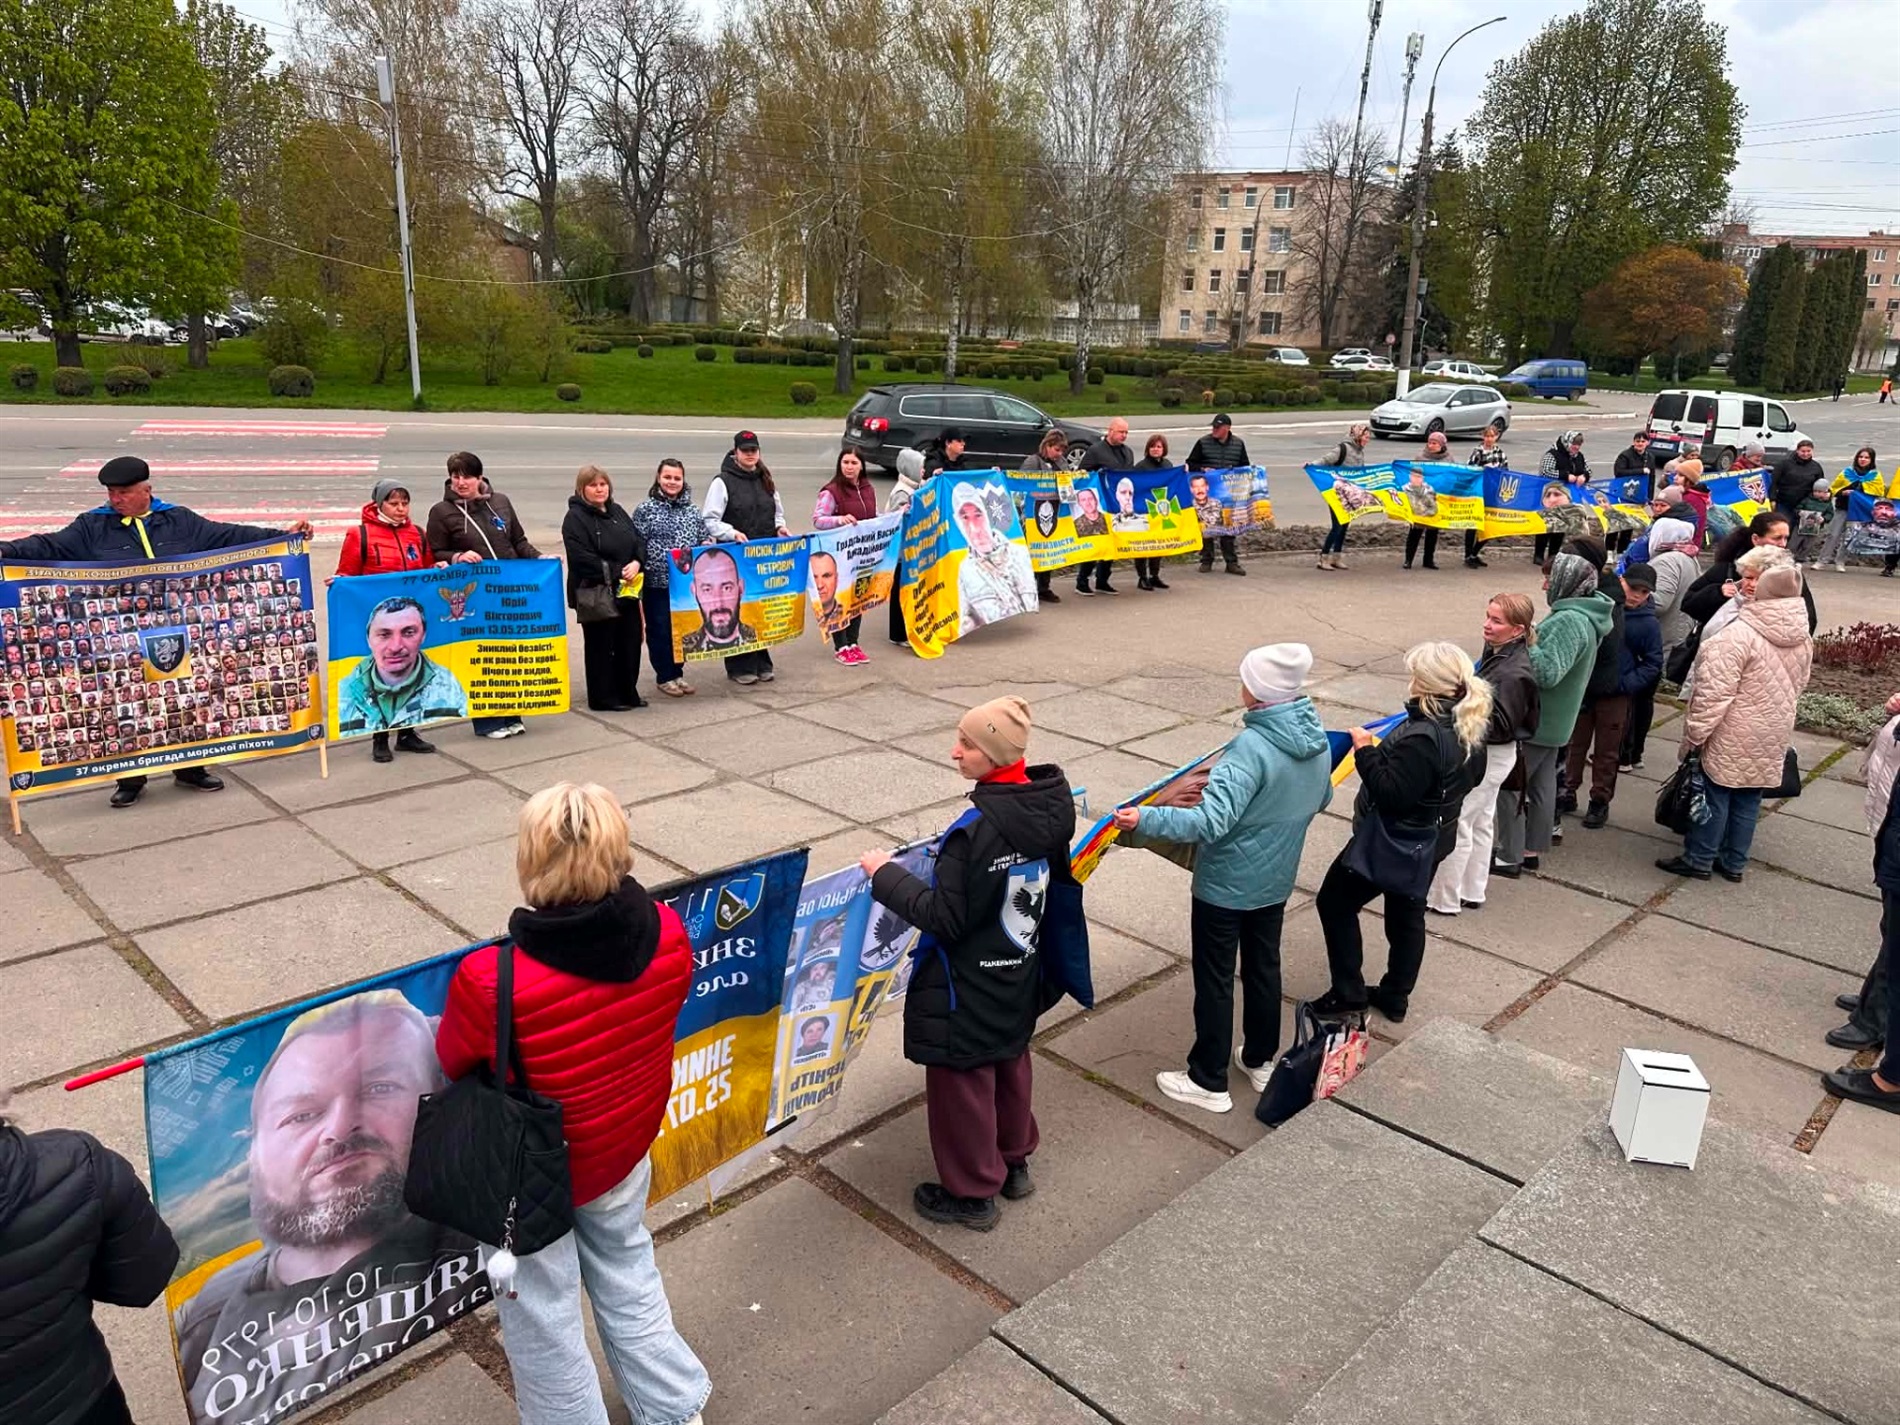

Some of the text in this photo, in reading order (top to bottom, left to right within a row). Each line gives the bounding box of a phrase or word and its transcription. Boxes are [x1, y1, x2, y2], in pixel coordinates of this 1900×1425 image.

[743, 538, 807, 558] ЛИСЮК ДМИТРО
[756, 558, 796, 576] ПЕТРОВИЧ
[402, 576, 417, 585] 77
[501, 597, 527, 608] Юрій
[485, 611, 543, 621] Вікторович
[477, 644, 517, 653] Зниклий
[470, 657, 481, 665] це
[483, 656, 494, 664] як
[495, 657, 517, 665] рана
[518, 655, 534, 664] без
[470, 679, 487, 687] але
[488, 679, 520, 687] болить
[469, 690, 481, 699] Це
[482, 690, 493, 698] як
[495, 690, 517, 699] крик
[517, 690, 523, 699] у
[472, 702, 486, 711] що
[488, 701, 516, 710] немає
[75, 738, 275, 776] 37 окрема бригада морської піхоти
